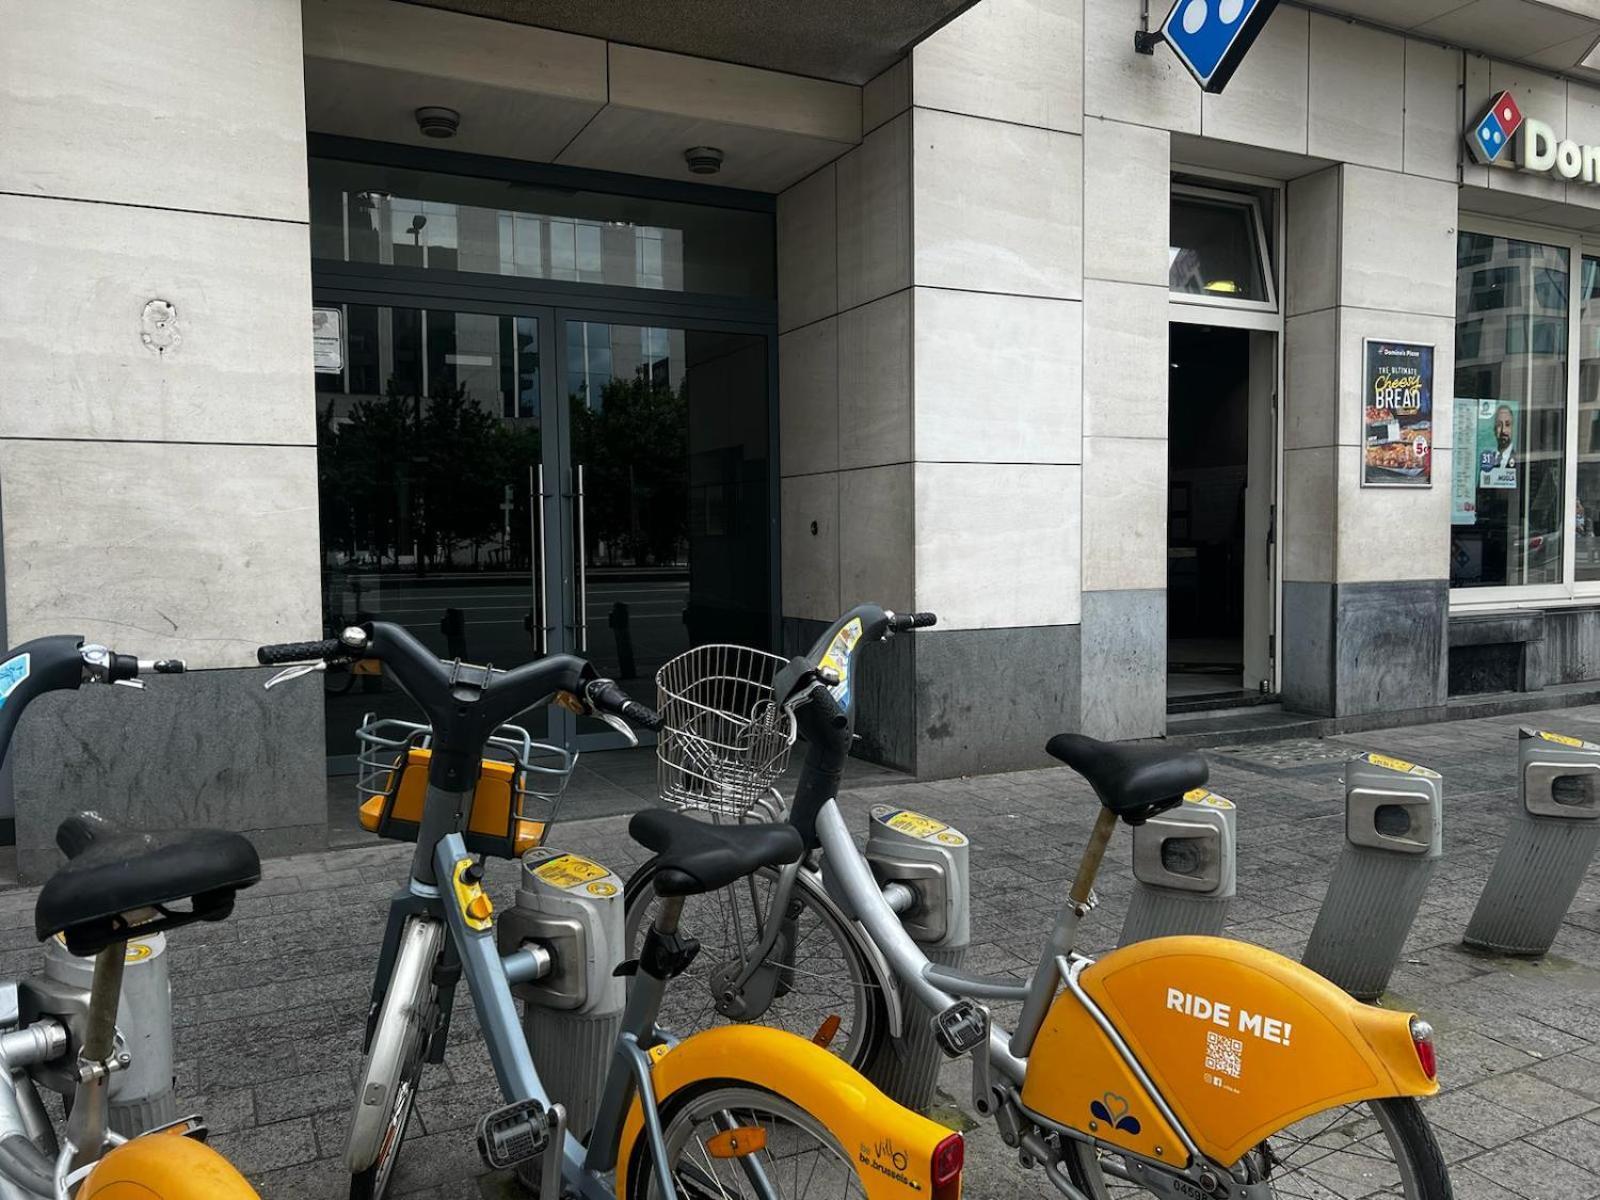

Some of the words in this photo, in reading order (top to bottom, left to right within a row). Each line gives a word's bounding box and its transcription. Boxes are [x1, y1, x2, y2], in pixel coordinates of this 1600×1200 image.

[1375, 373, 1422, 395] Cheesy
[1375, 389, 1421, 409] BREAD
[1166, 987, 1231, 1028] RIDE
[1238, 1009, 1292, 1047] ME!
